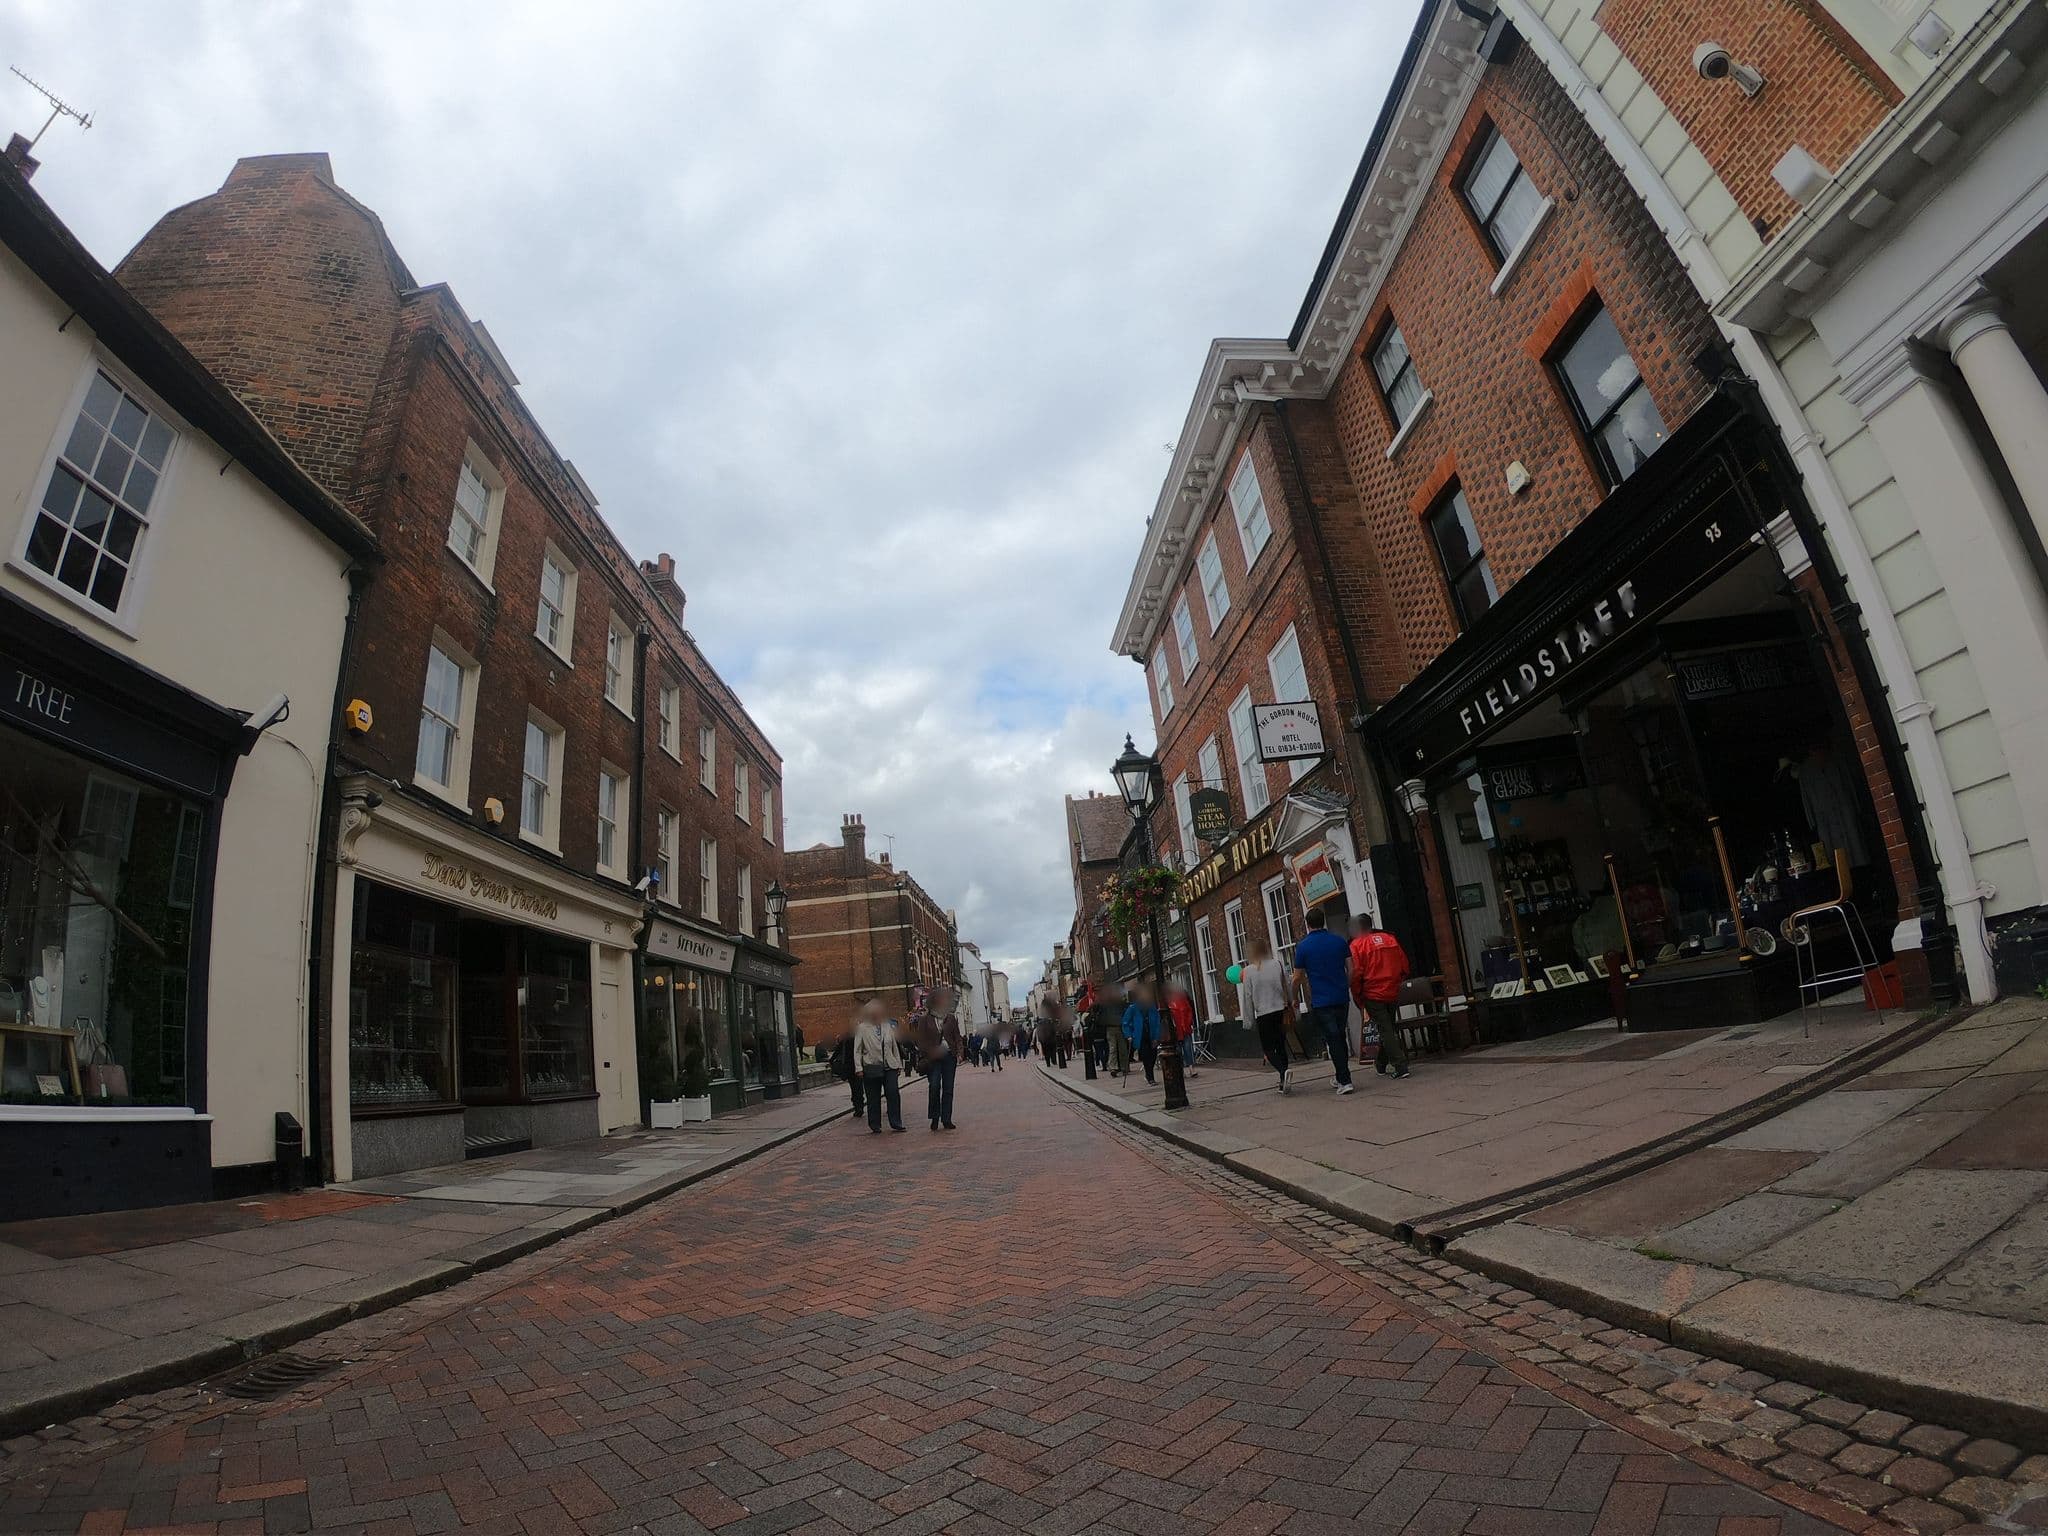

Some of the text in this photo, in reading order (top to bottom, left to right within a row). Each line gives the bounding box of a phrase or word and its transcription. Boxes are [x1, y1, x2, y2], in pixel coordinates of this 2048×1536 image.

[1705, 521, 1721, 543] 93
[15, 670, 75, 724] TREE
[1257, 708, 1320, 730] THE GORDON HOUSE
[1281, 734, 1302, 742] HOTEL
[1264, 745, 1277, 754] TEL
[1197, 812, 1226, 822] STEAK
[1198, 820, 1227, 830] HOUSE
[1231, 817, 1277, 872] HOTEL
[421, 851, 468, 891] Denis
